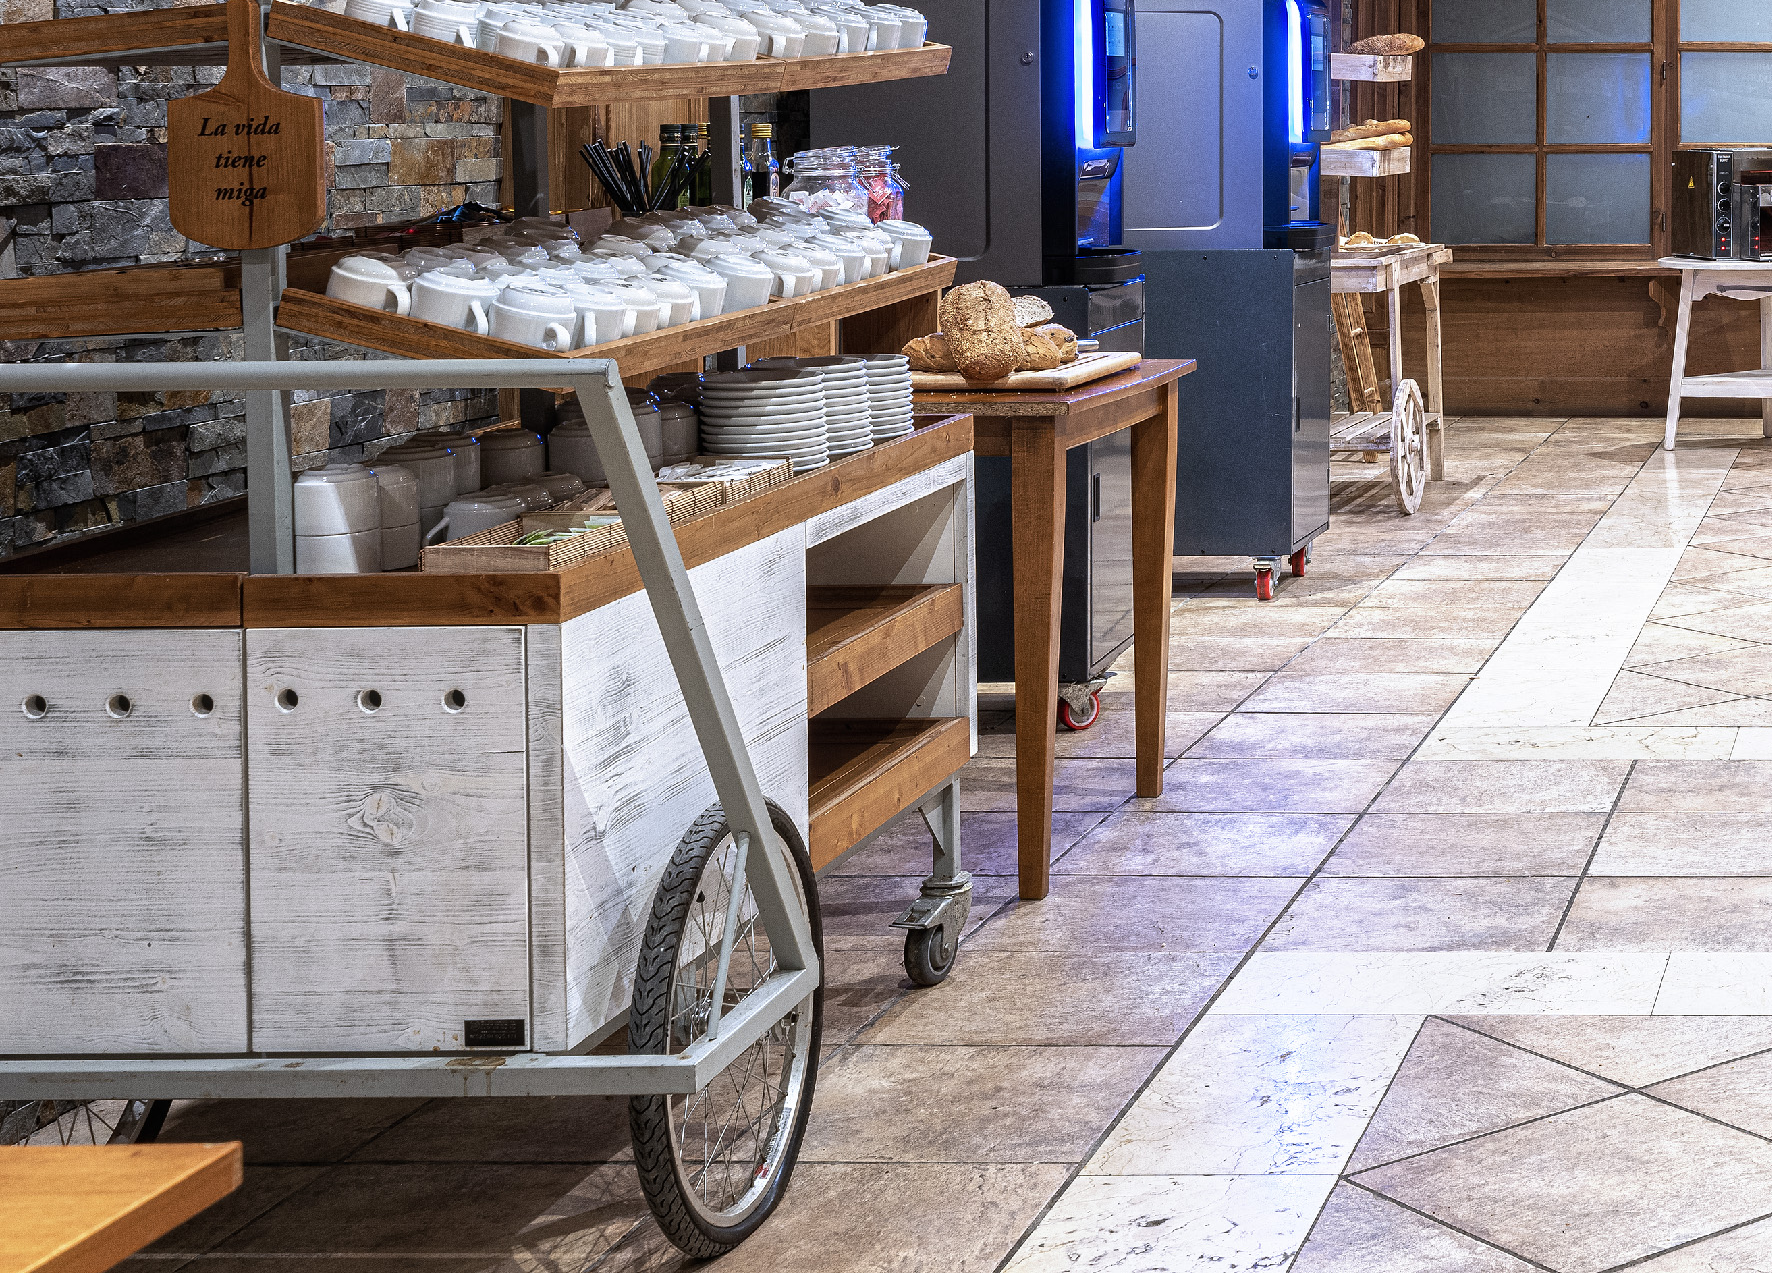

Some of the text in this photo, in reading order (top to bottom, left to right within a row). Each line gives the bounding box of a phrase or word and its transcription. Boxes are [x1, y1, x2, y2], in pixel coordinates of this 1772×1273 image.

[197, 115, 281, 137] La vida
[214, 150, 267, 168] tiene
[214, 181, 268, 207] miga
